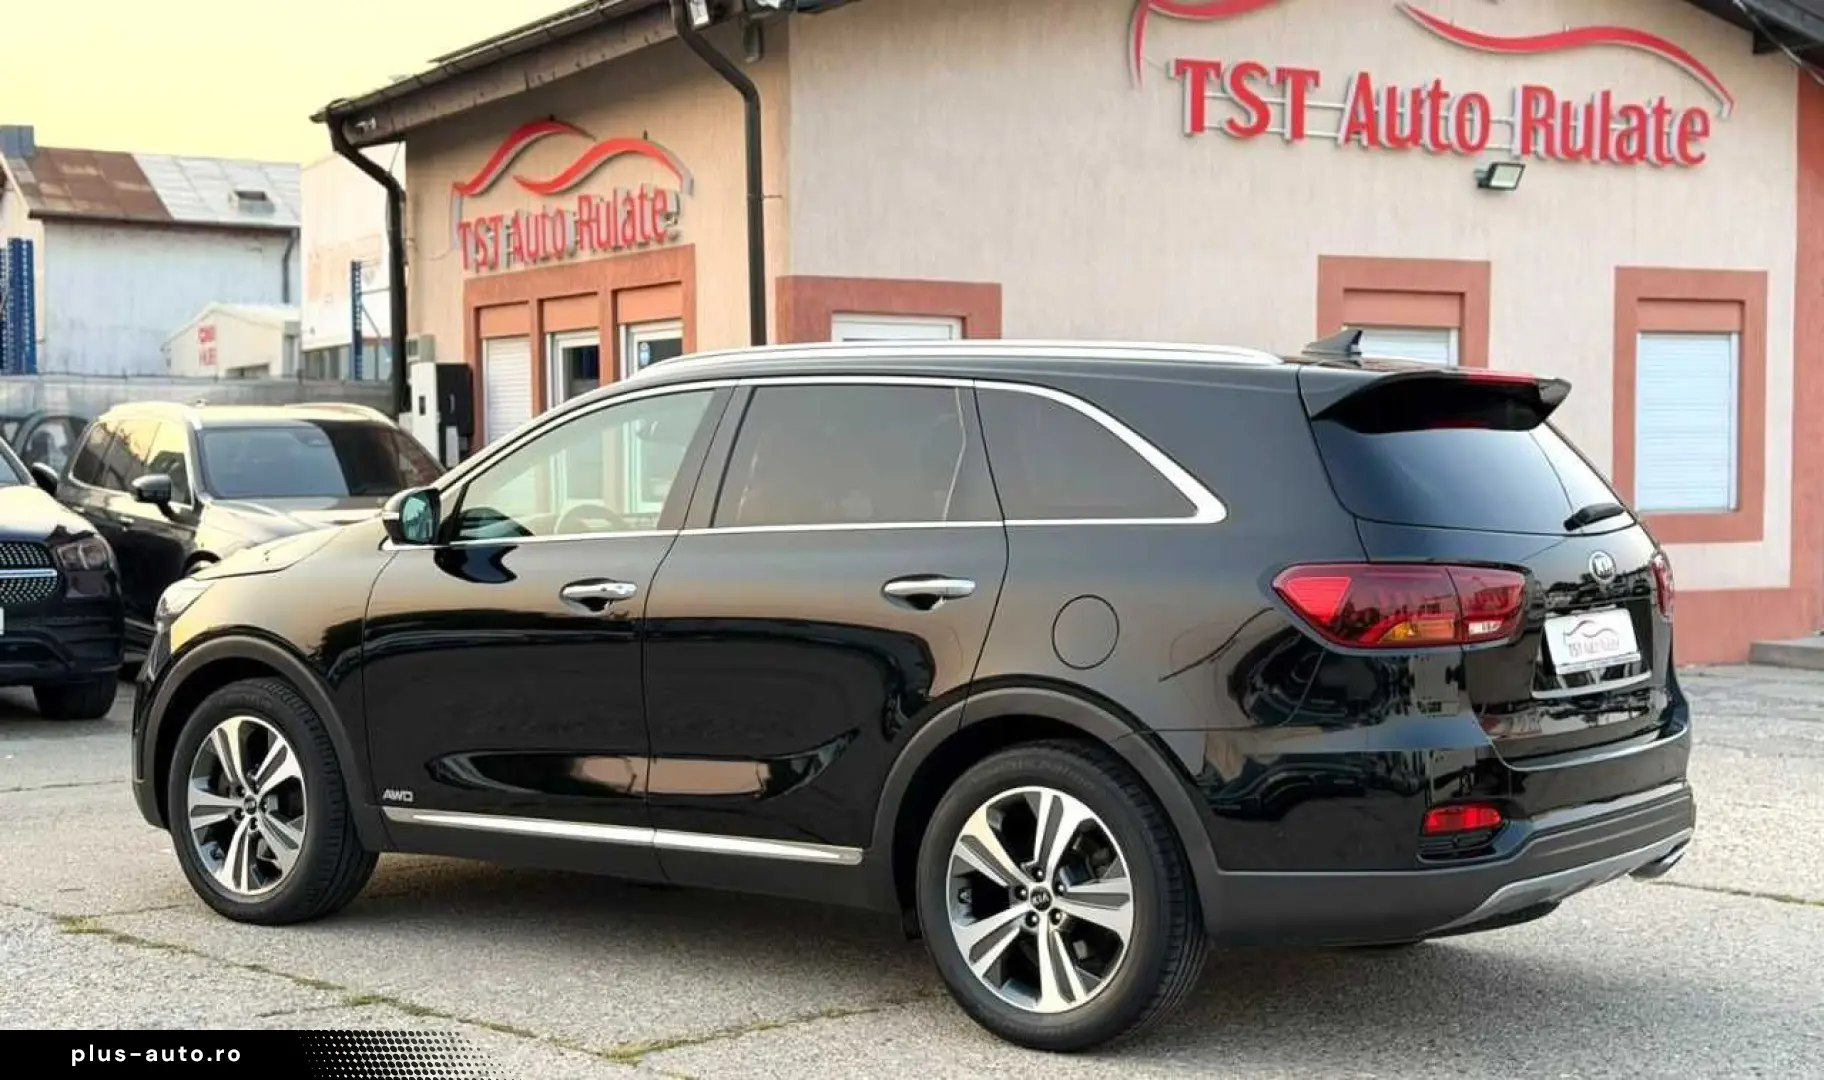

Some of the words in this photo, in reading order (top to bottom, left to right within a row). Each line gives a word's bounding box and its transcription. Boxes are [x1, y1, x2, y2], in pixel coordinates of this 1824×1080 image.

[1174, 58, 1320, 142] TST
[1339, 71, 1491, 154] Auto
[1514, 84, 1711, 167] Rulate
[458, 214, 504, 272] TST
[510, 205, 568, 264] Auto
[576, 182, 667, 251] Rulate
[382, 788, 414, 802] AWD
